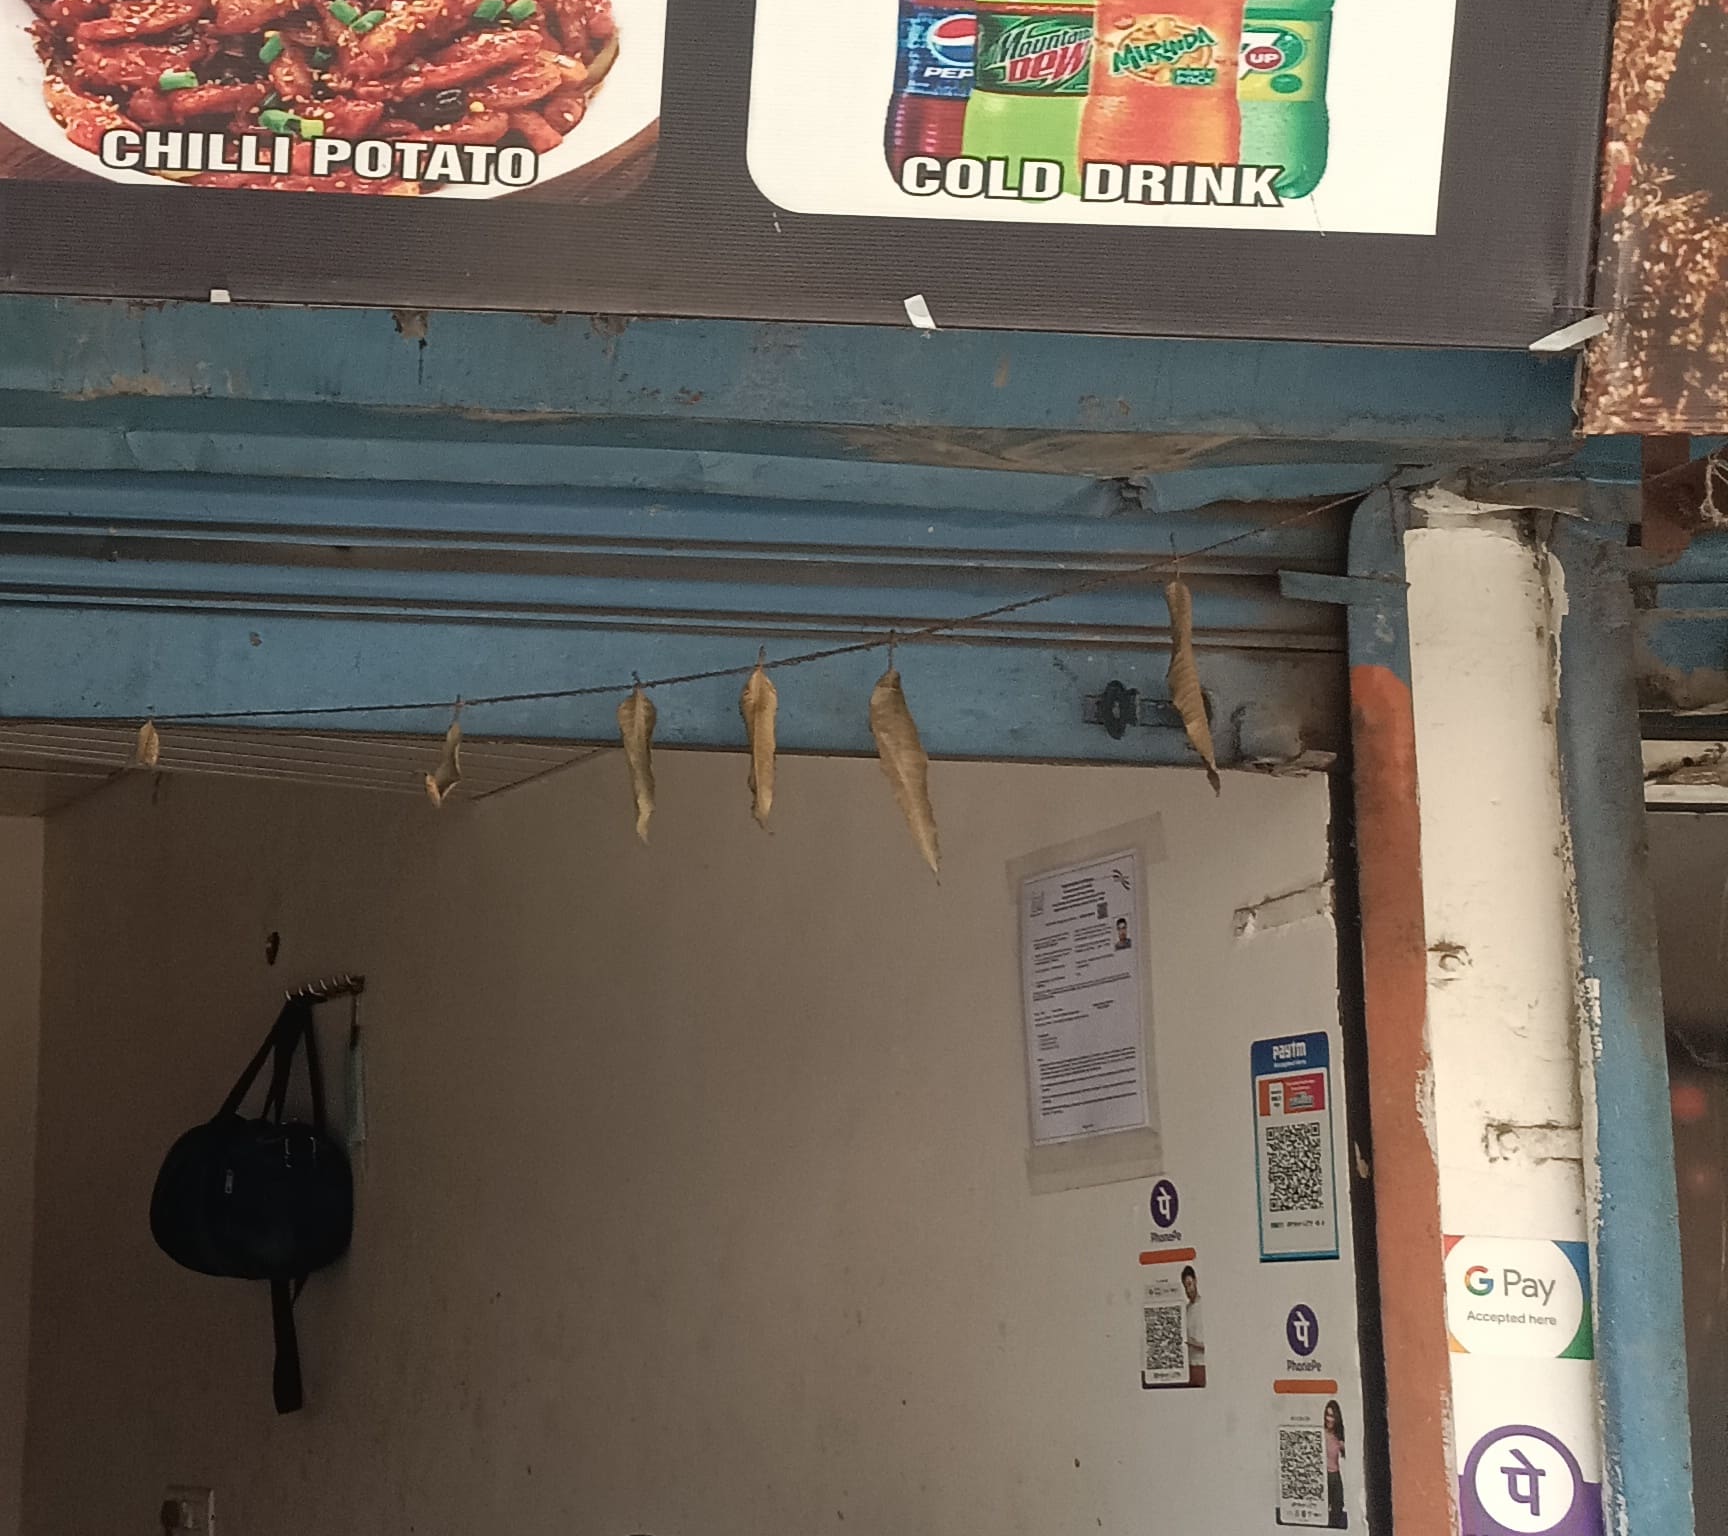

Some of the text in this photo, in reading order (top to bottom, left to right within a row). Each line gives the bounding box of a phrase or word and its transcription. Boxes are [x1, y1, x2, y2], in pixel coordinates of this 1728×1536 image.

[924, 66, 973, 79] PEP
[99, 128, 540, 188] CHILLI POTATO
[900, 155, 1284, 207] COLD DRINK
[1503, 1268, 1556, 1306] Pay
[1467, 1310, 1557, 1326] Accepted here
